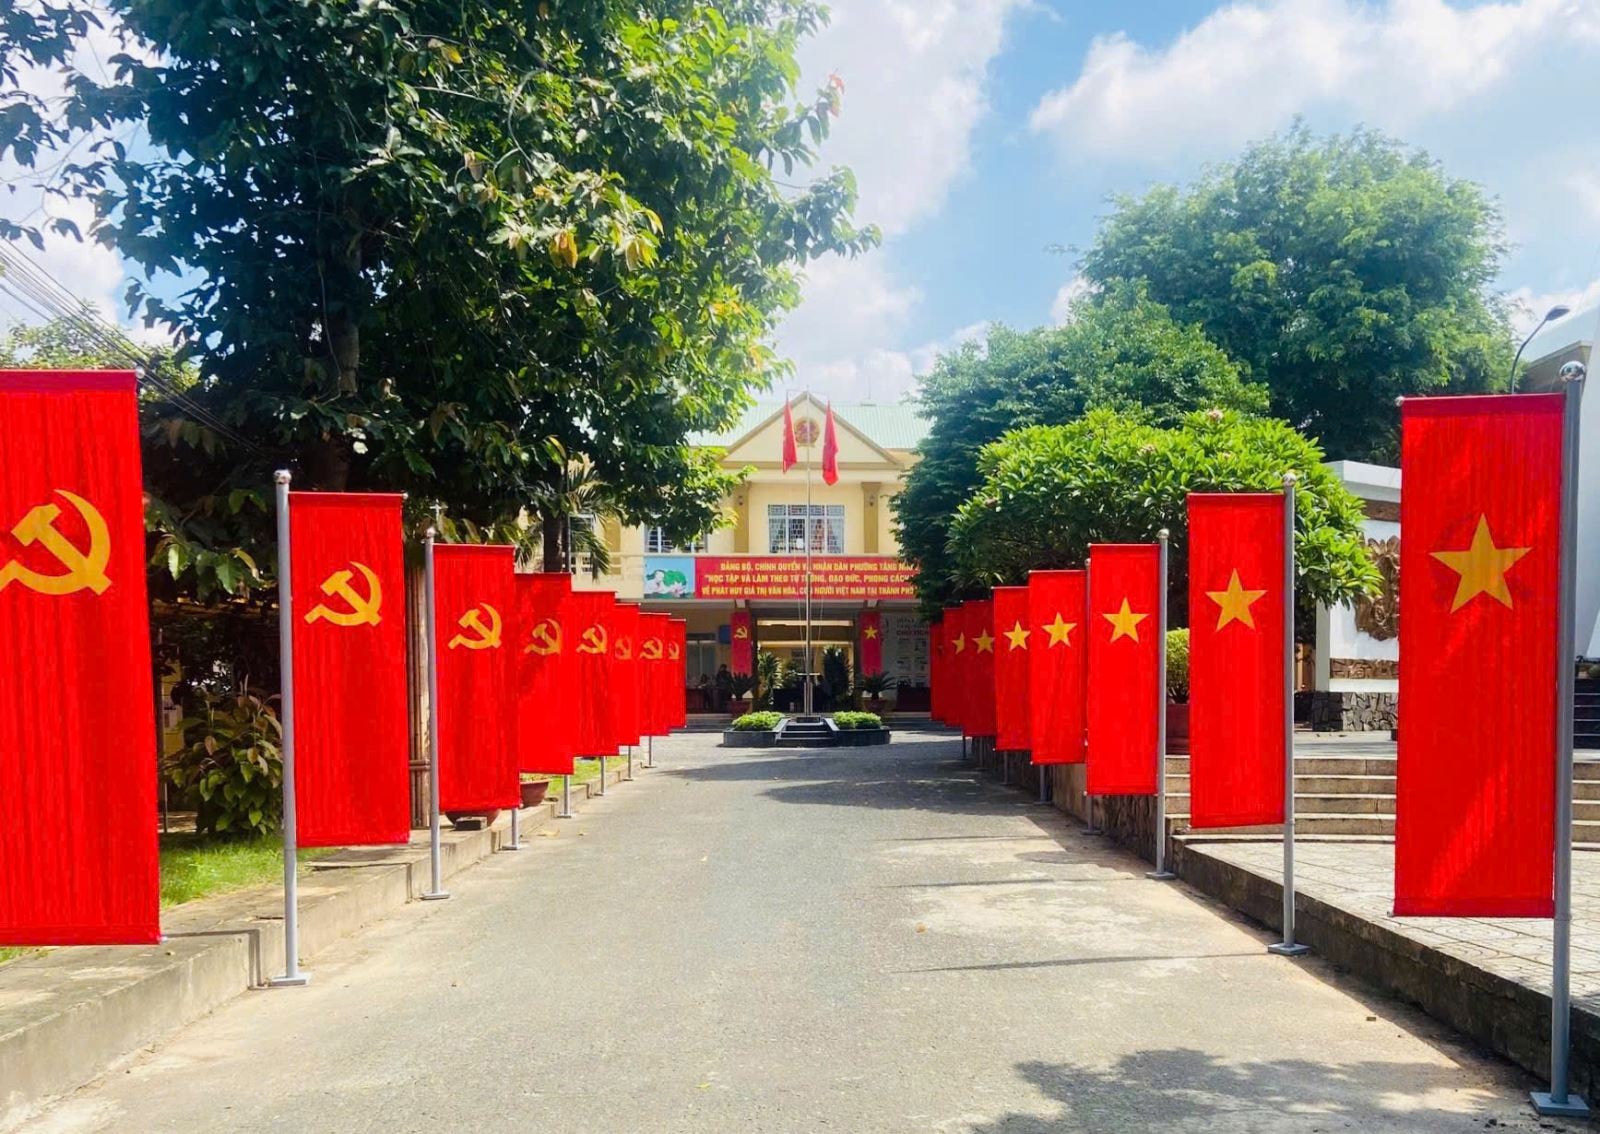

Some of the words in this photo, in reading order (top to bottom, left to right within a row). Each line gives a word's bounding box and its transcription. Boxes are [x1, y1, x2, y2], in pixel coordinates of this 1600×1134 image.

[755, 561, 777, 571] CHÍNH
[802, 561, 812, 571] V
[770, 575, 788, 583] THEO
[801, 573, 827, 583] TỞNG,
[863, 574, 888, 583] PHONG
[729, 586, 742, 595] HUY
[850, 586, 865, 595] NAM
